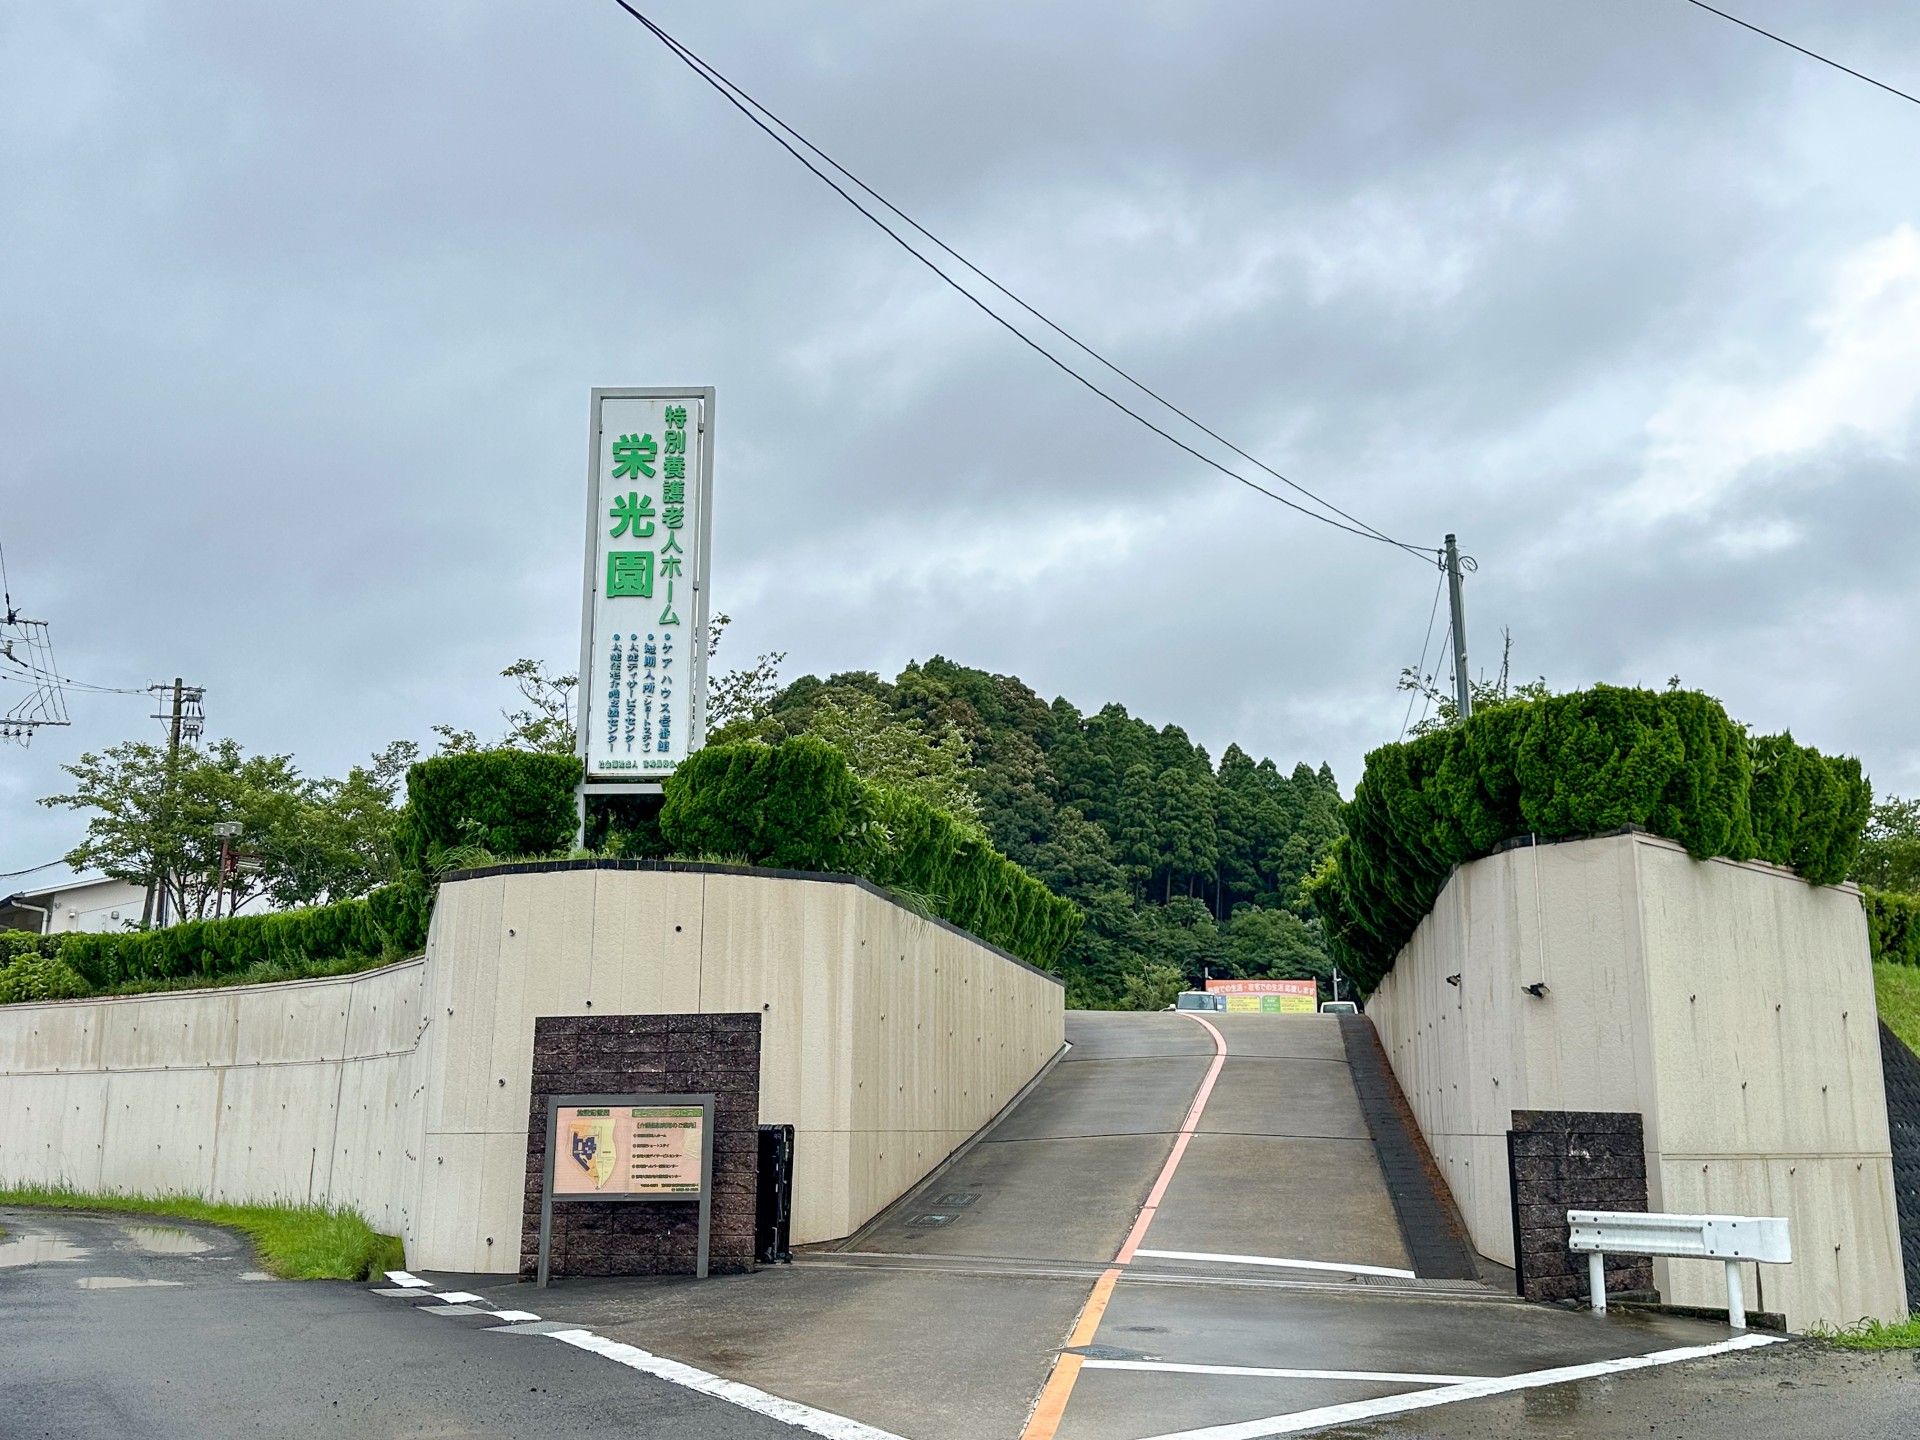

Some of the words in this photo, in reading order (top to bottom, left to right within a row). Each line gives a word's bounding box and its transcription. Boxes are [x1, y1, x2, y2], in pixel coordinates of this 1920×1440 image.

[606, 432, 658, 599] 栄光園
[658, 404, 688, 626] 特別養護老人ホーム
